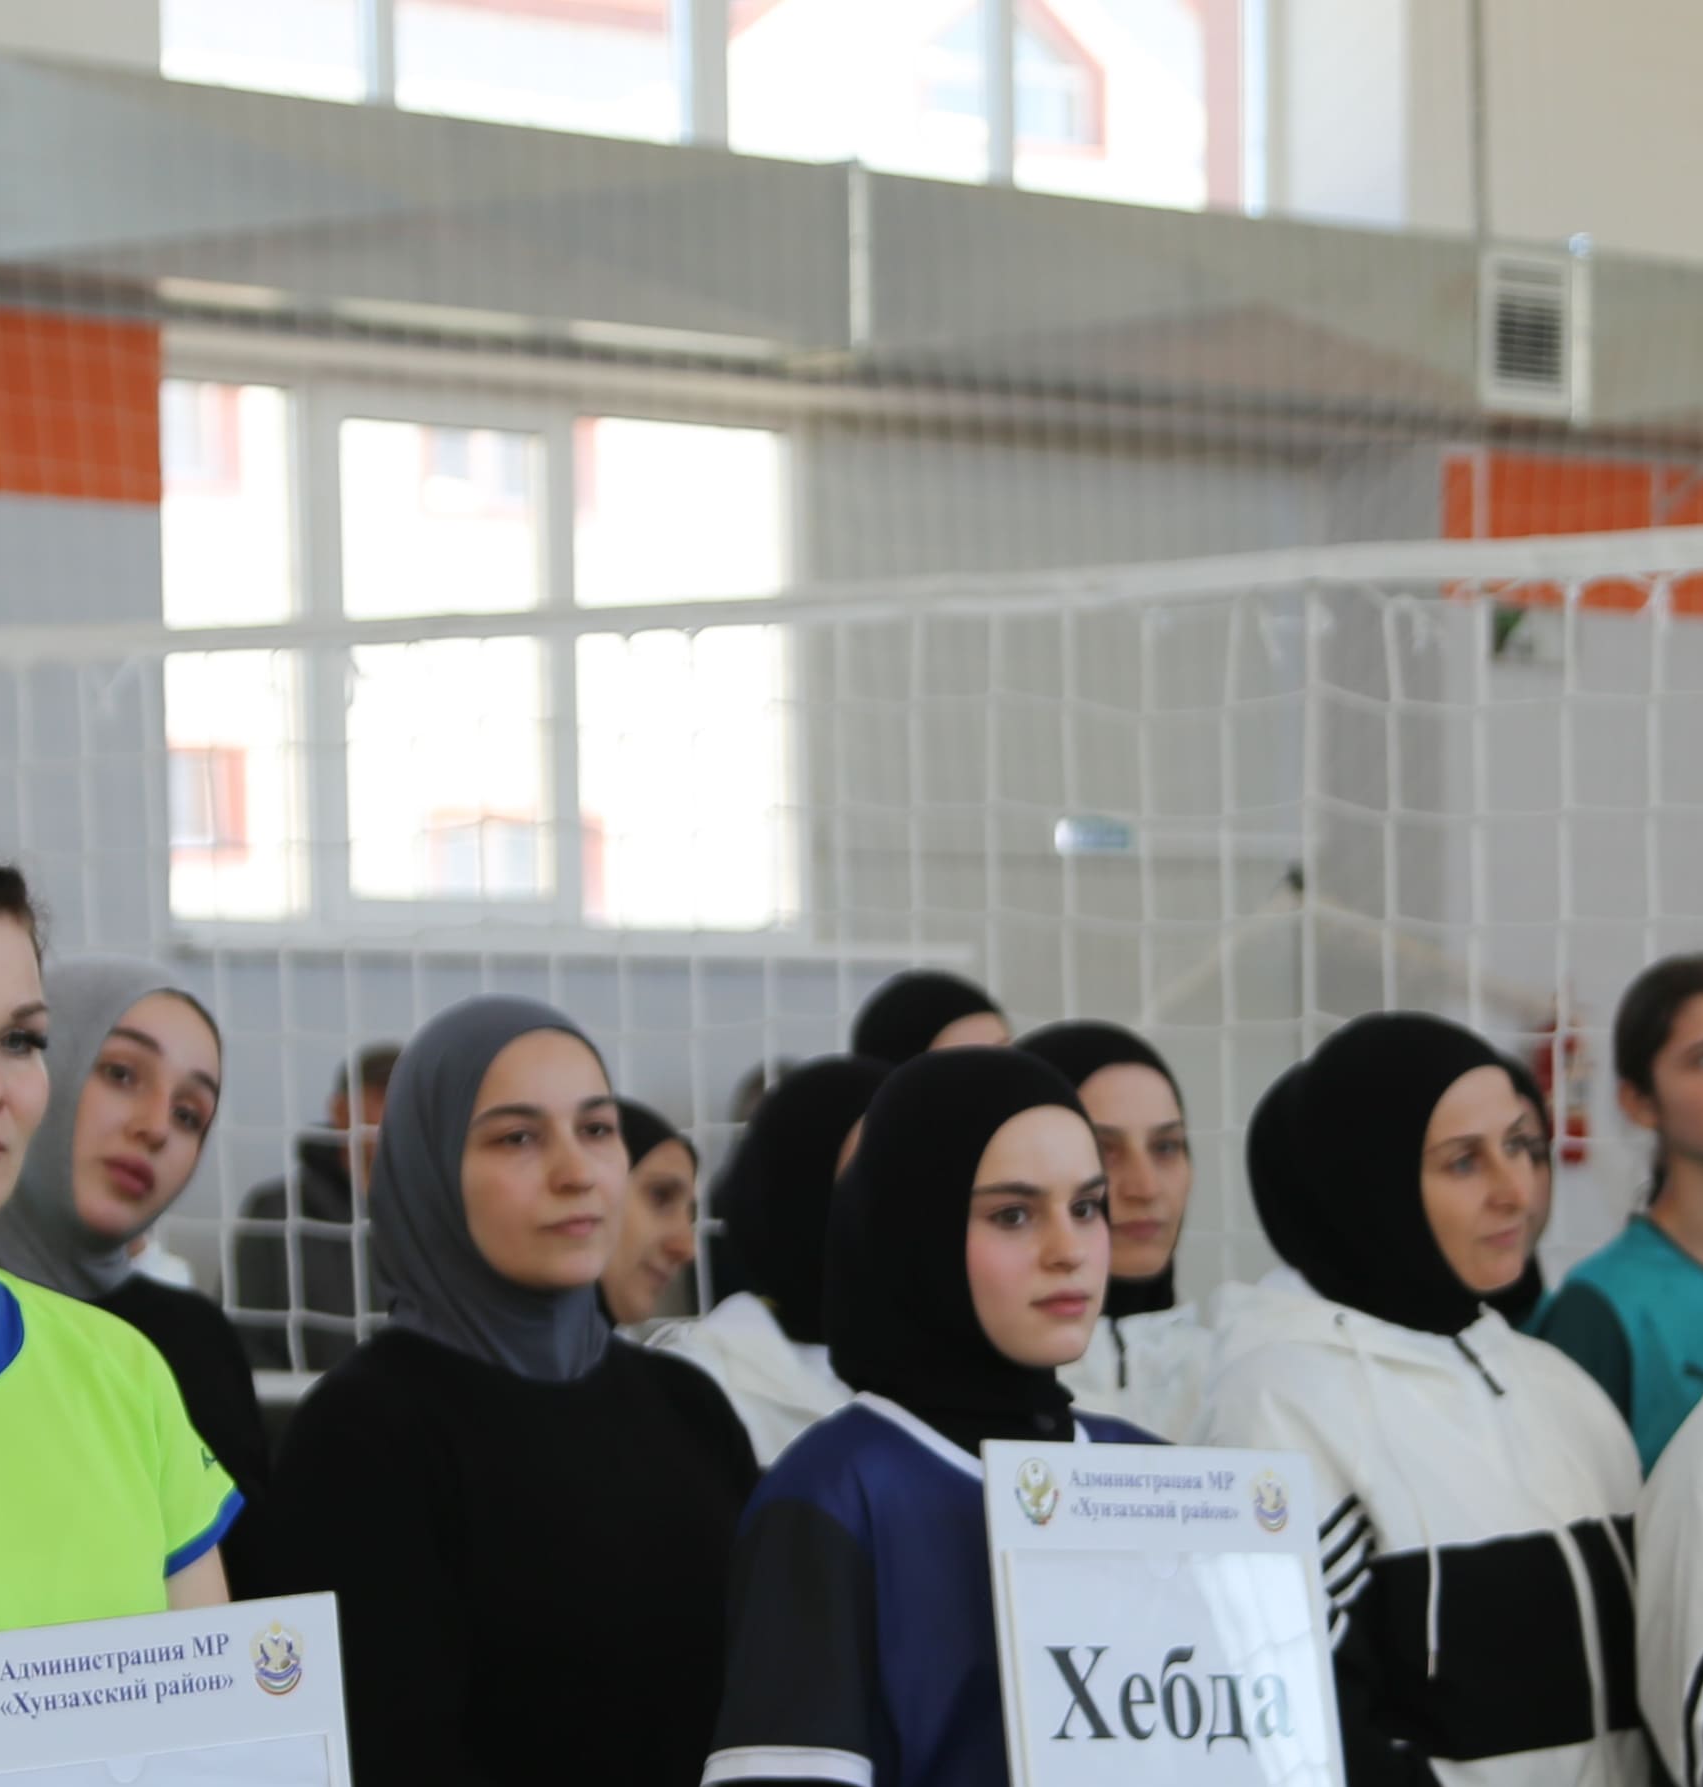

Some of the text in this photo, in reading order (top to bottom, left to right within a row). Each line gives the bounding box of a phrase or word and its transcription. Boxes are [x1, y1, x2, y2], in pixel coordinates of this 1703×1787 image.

[0, 1632, 230, 1682] Администрация МР
[0, 1671, 235, 1719] «Хунзахский район»
[1044, 1645, 1295, 1754] Хебда
